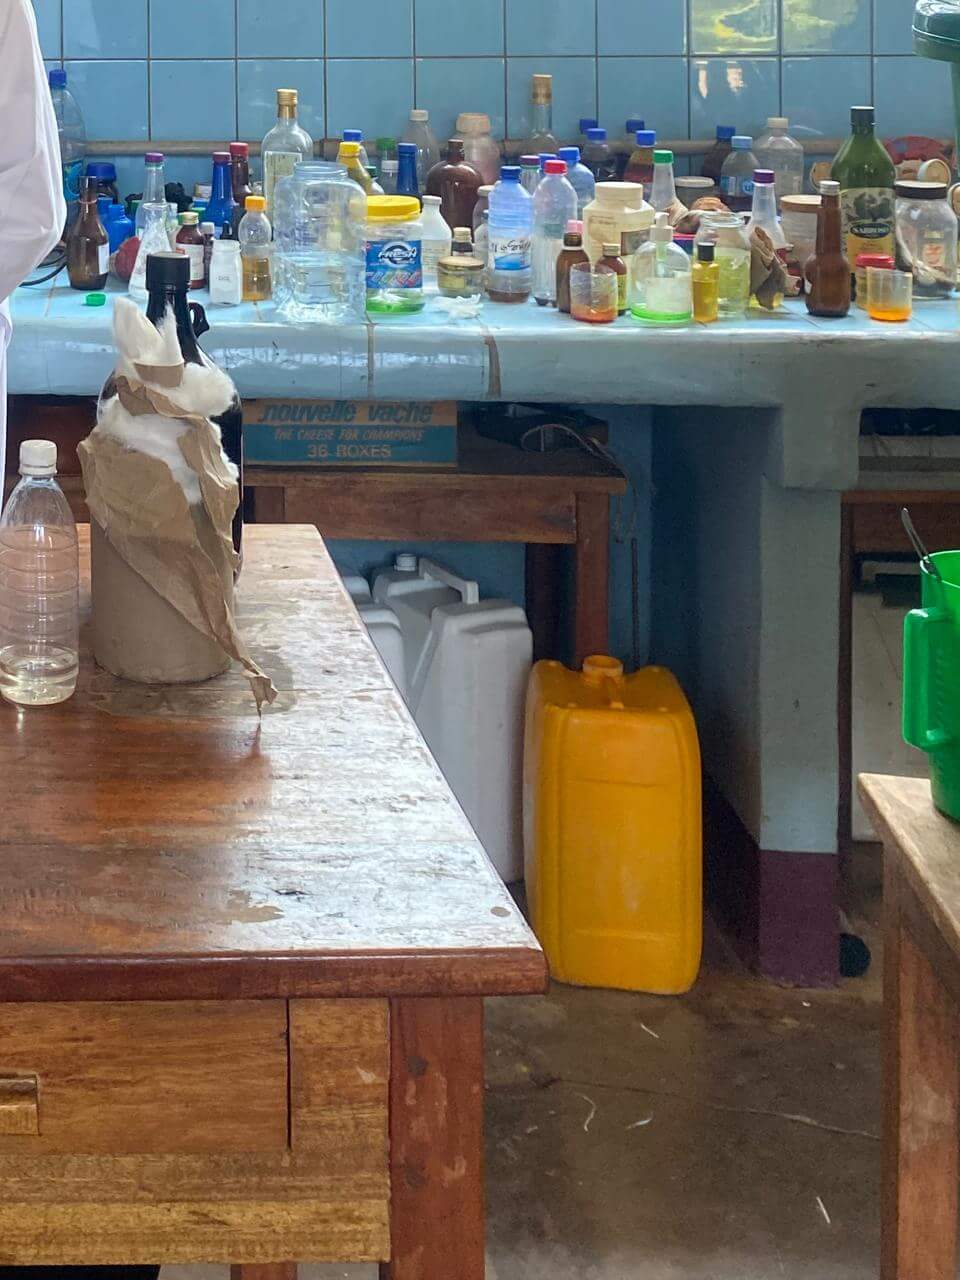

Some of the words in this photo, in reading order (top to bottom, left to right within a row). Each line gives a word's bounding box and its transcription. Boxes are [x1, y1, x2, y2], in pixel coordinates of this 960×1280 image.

[367, 401, 435, 423] vache
[307, 444, 328, 458] 36
[335, 444, 392, 458] BOXES
